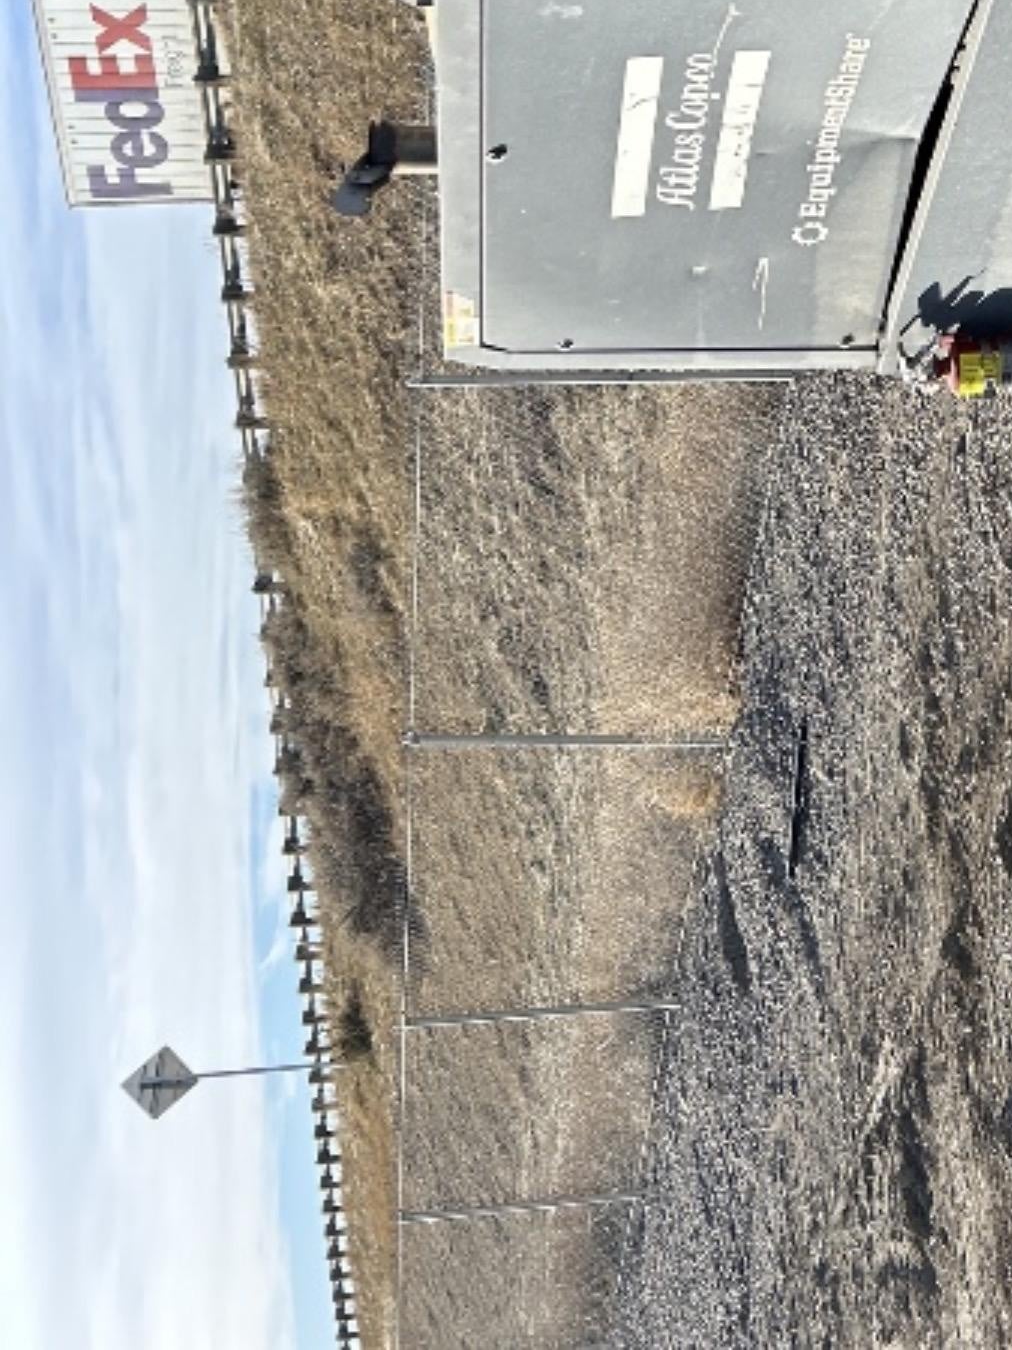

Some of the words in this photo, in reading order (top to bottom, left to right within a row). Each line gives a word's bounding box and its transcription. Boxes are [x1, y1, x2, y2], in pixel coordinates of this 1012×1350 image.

[68, 3, 173, 198] FedEx
[664, 52, 721, 130] Copco
[655, 133, 705, 211] Atlas
